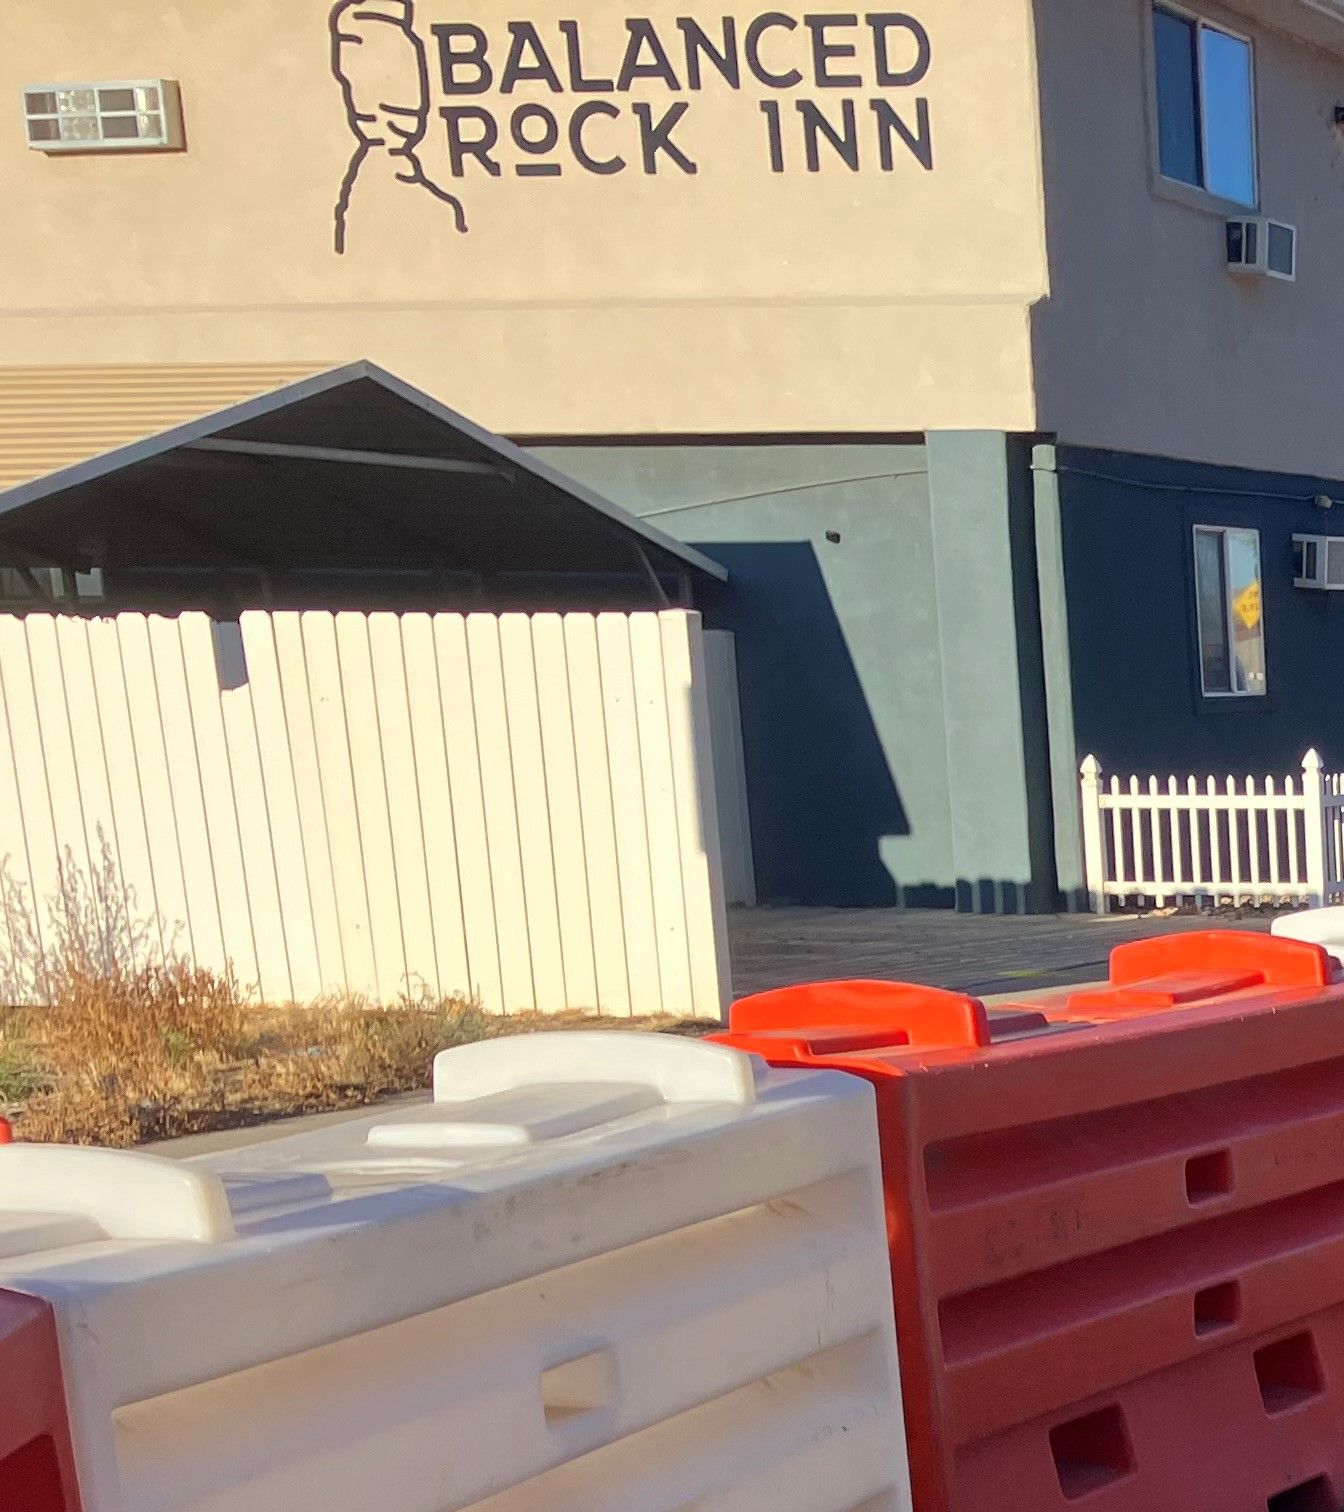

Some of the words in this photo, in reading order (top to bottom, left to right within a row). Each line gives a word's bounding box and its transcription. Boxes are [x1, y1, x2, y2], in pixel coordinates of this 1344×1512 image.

[431, 12, 931, 95] BALANCED
[439, 101, 697, 178] ROCK
[760, 96, 934, 173] INN
